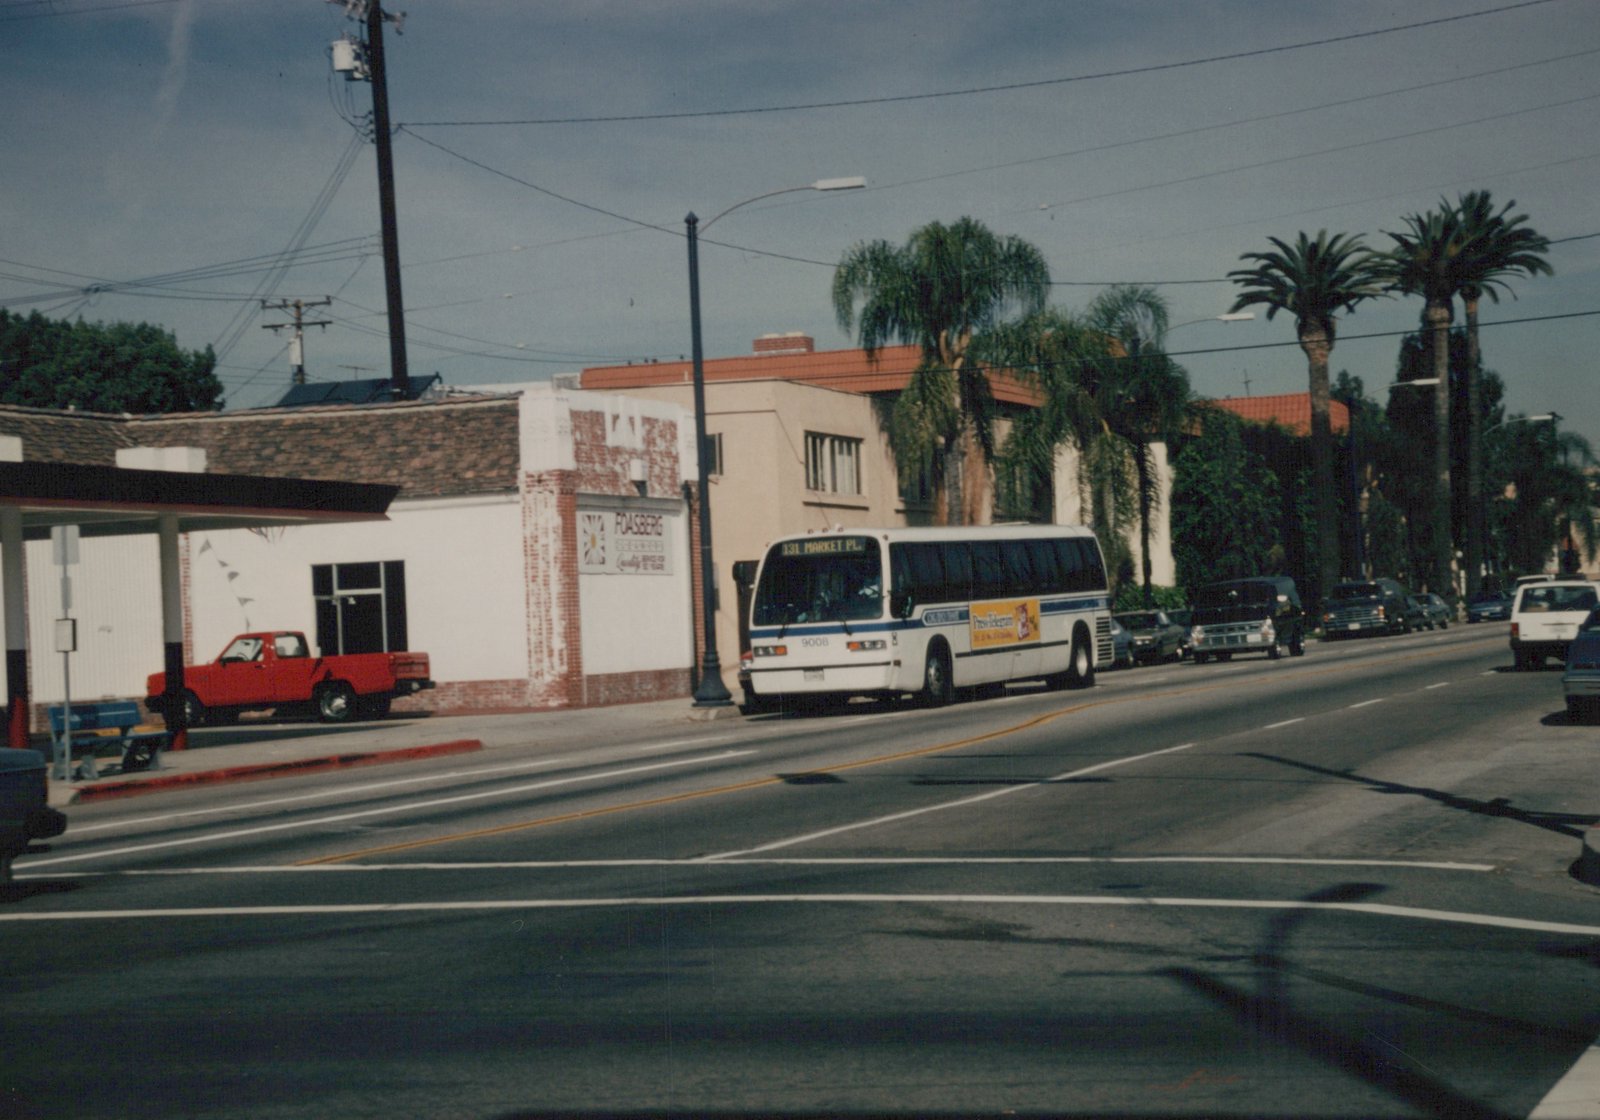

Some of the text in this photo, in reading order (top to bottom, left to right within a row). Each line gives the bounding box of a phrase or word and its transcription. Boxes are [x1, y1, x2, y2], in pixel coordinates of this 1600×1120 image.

[614, 512, 662, 536] FOASBERG
[783, 543, 800, 555] 131
[804, 540, 842, 554] MARKET
[801, 637, 829, 648] 9008
